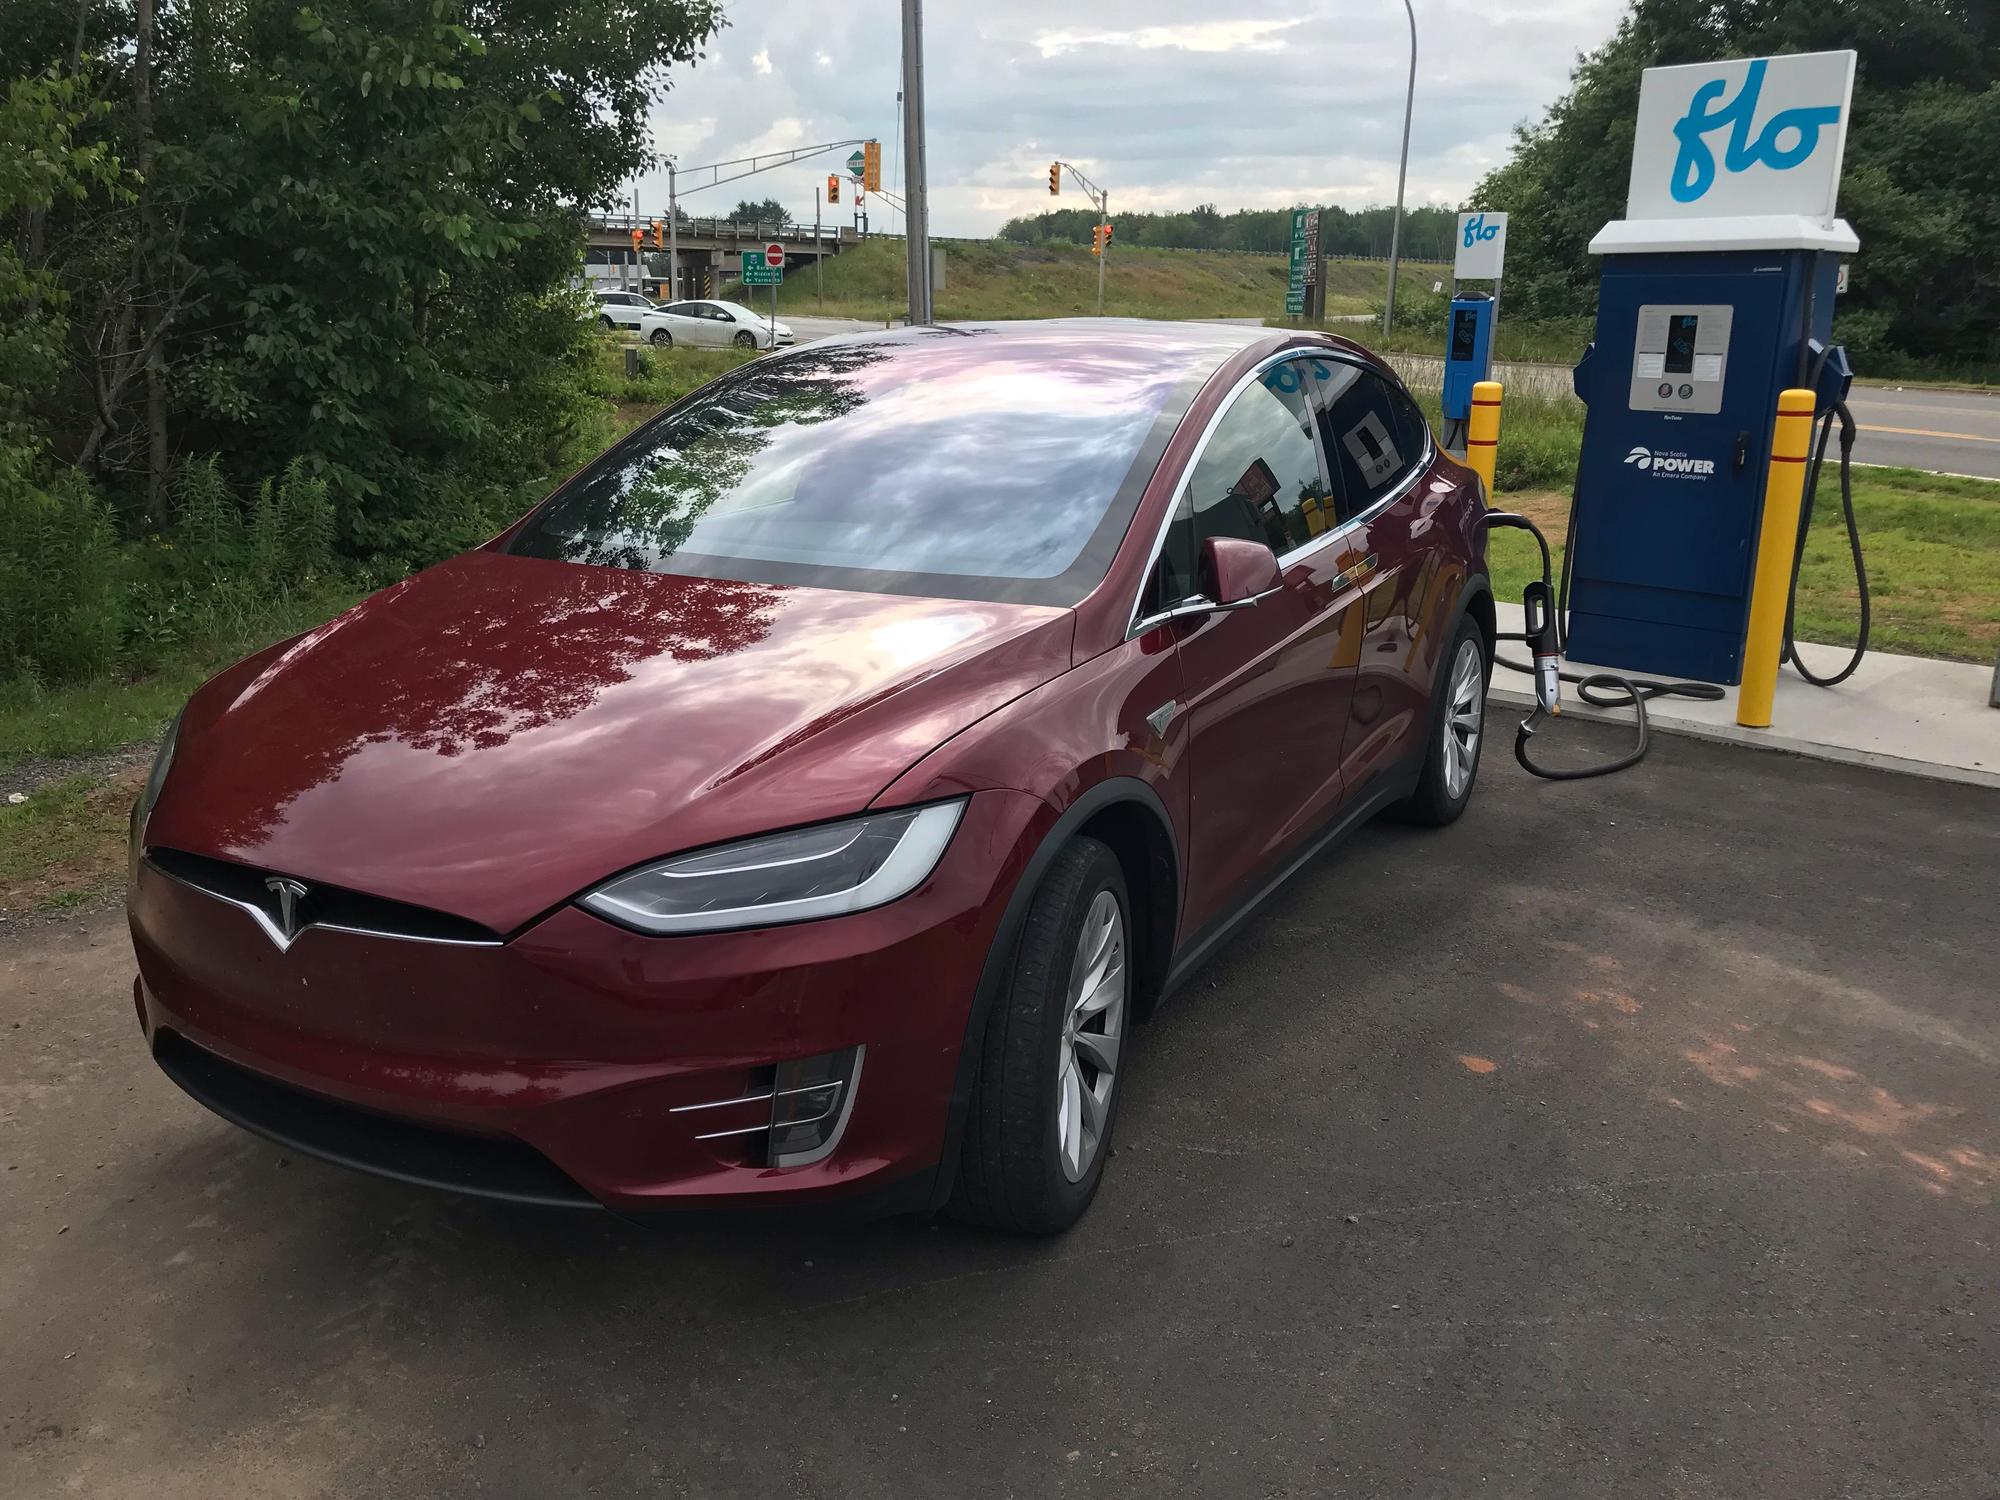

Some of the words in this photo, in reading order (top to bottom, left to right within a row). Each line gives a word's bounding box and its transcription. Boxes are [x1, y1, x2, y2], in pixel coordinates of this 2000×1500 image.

[1669, 59, 1842, 203] flo
[1463, 213, 1500, 248] flo
[1669, 450, 1687, 458] Scotia
[1652, 457, 1714, 474] POWER
[1680, 473, 1707, 481] Company
